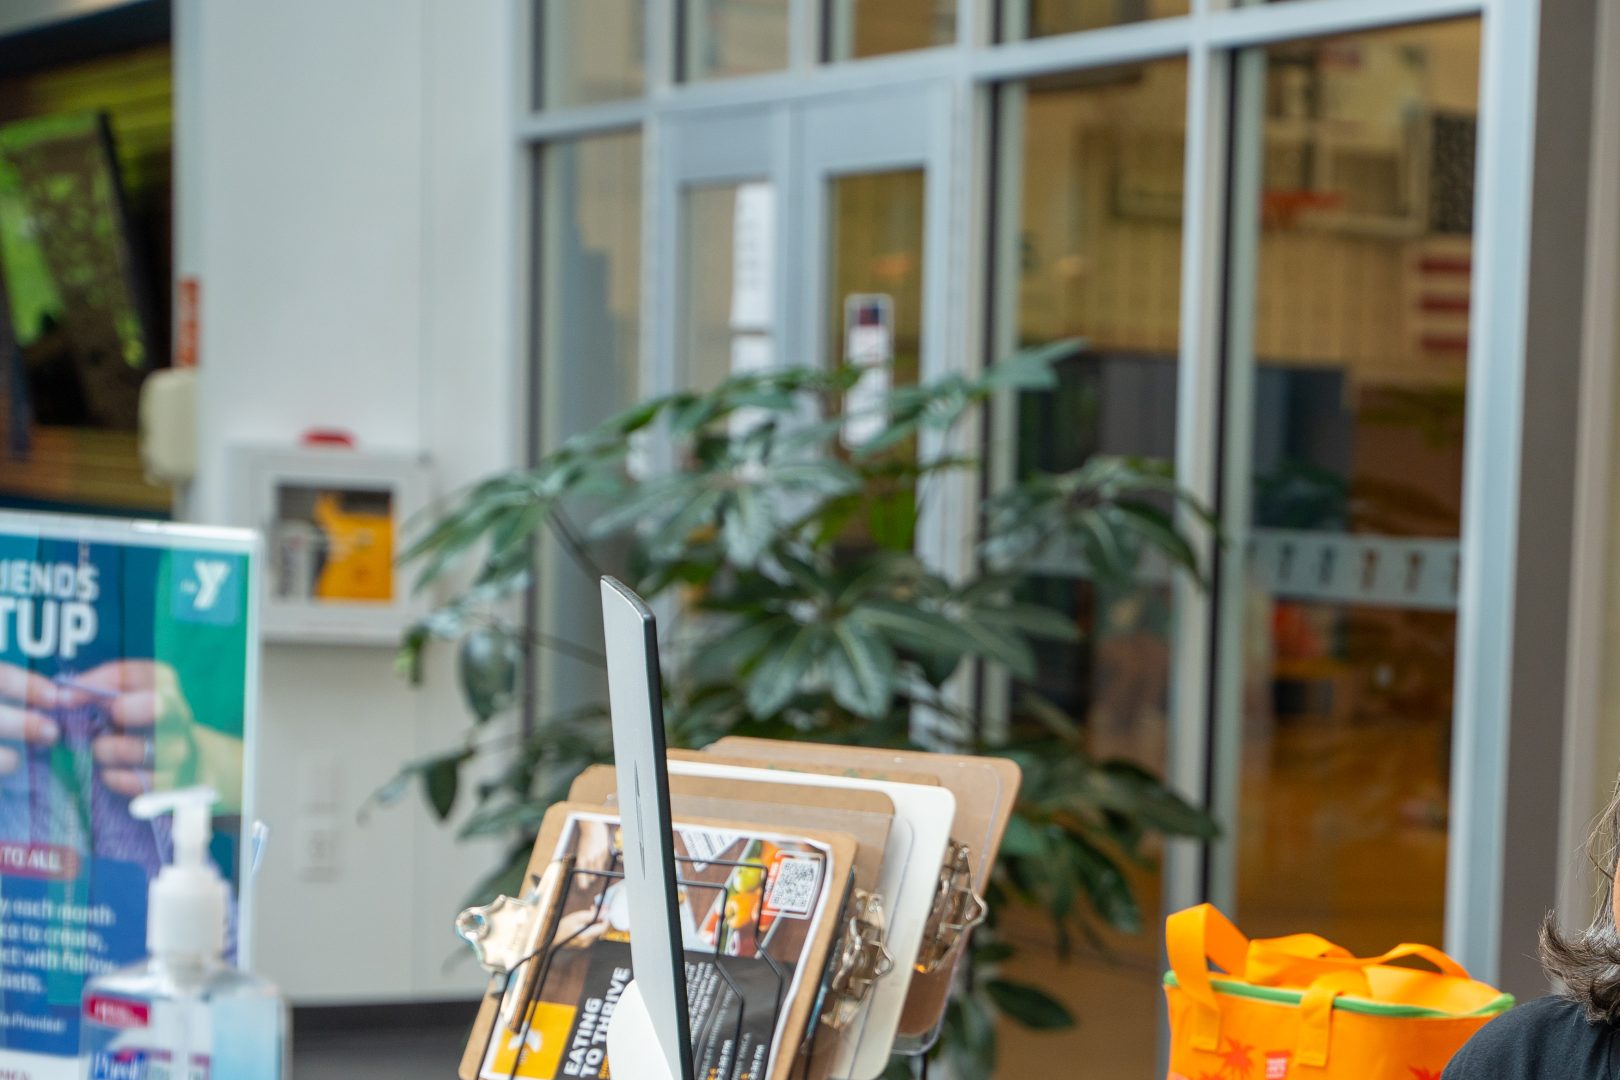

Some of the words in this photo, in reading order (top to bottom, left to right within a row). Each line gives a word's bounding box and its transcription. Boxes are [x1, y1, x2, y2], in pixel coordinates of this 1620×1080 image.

[563, 997, 602, 1076] EATING
[591, 967, 631, 1046] THRIVE
[580, 1048, 604, 1078] TO
